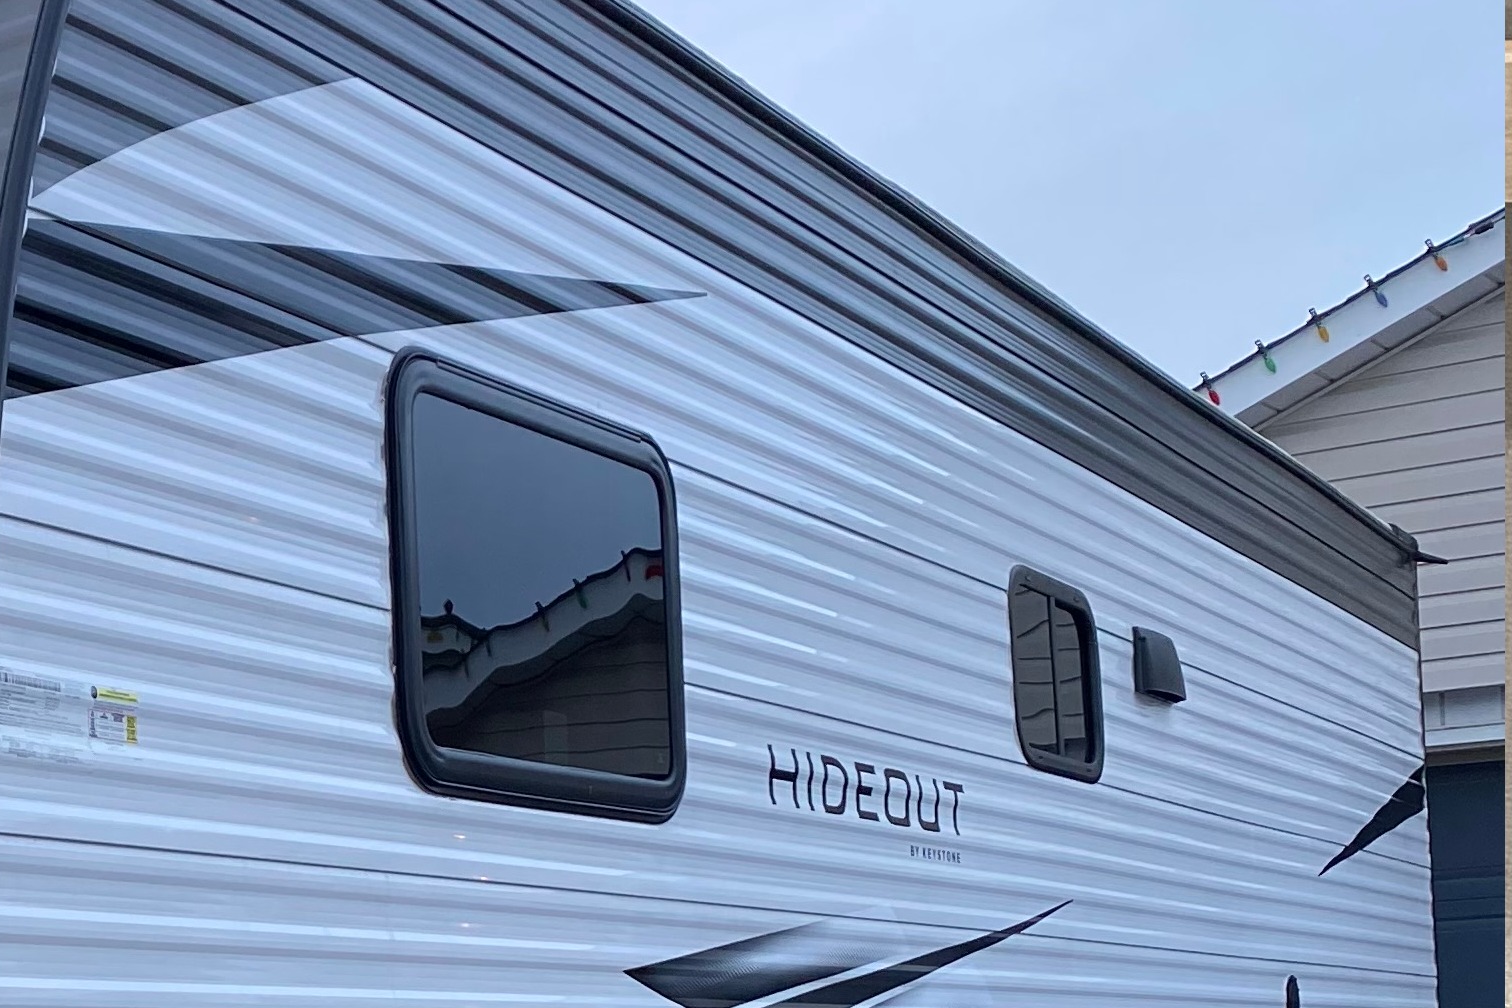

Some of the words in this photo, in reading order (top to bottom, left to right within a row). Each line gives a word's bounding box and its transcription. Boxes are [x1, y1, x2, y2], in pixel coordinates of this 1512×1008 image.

[767, 743, 965, 836] HIDEOUT
[910, 845, 920, 857] BY
[922, 847, 962, 864] KEYSTONE
